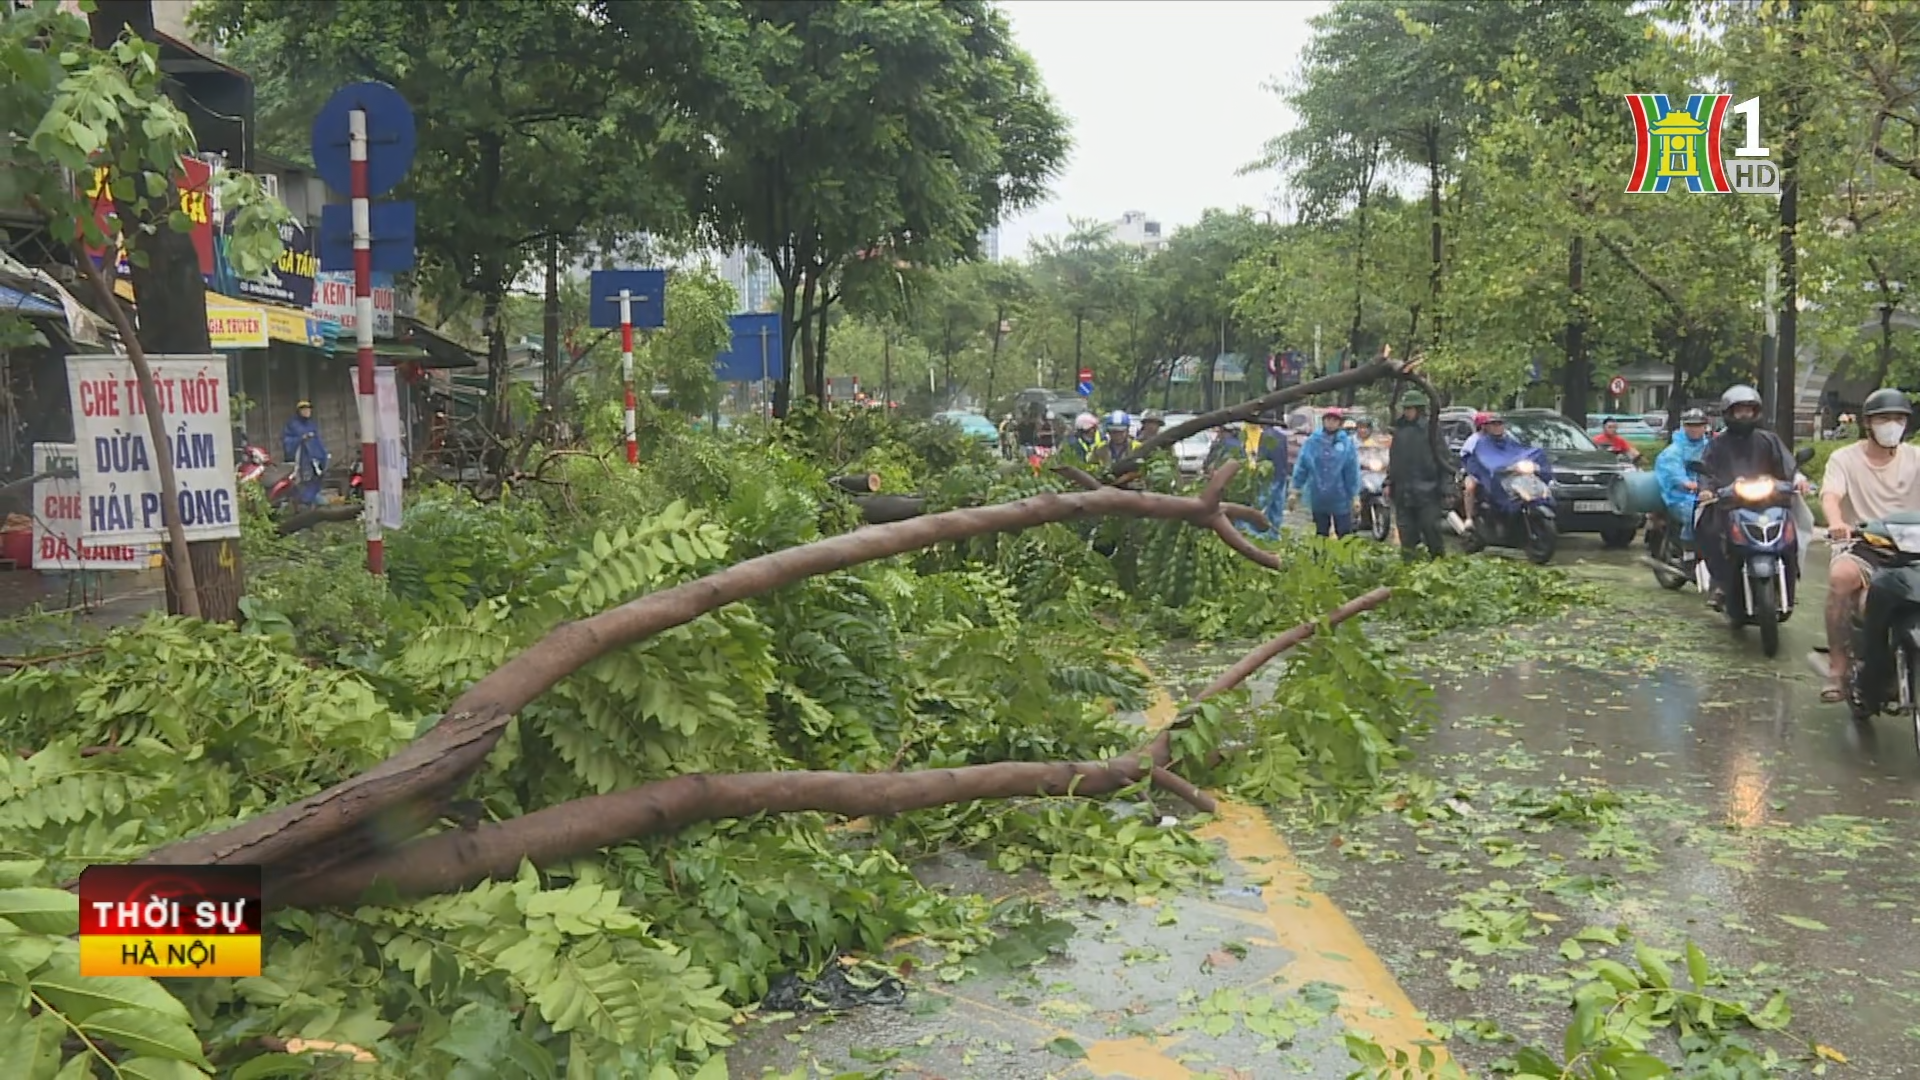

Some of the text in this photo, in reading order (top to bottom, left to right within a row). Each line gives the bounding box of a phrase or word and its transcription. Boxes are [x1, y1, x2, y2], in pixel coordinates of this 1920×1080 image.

[323, 282, 346, 307] KEM
[376, 314, 389, 332] 36
[79, 372, 120, 417] CHÈ
[180, 366, 219, 415] NỐT
[95, 428, 149, 473] DỪA
[44, 491, 82, 520] CHÈ
[89, 482, 134, 531] HẢI
